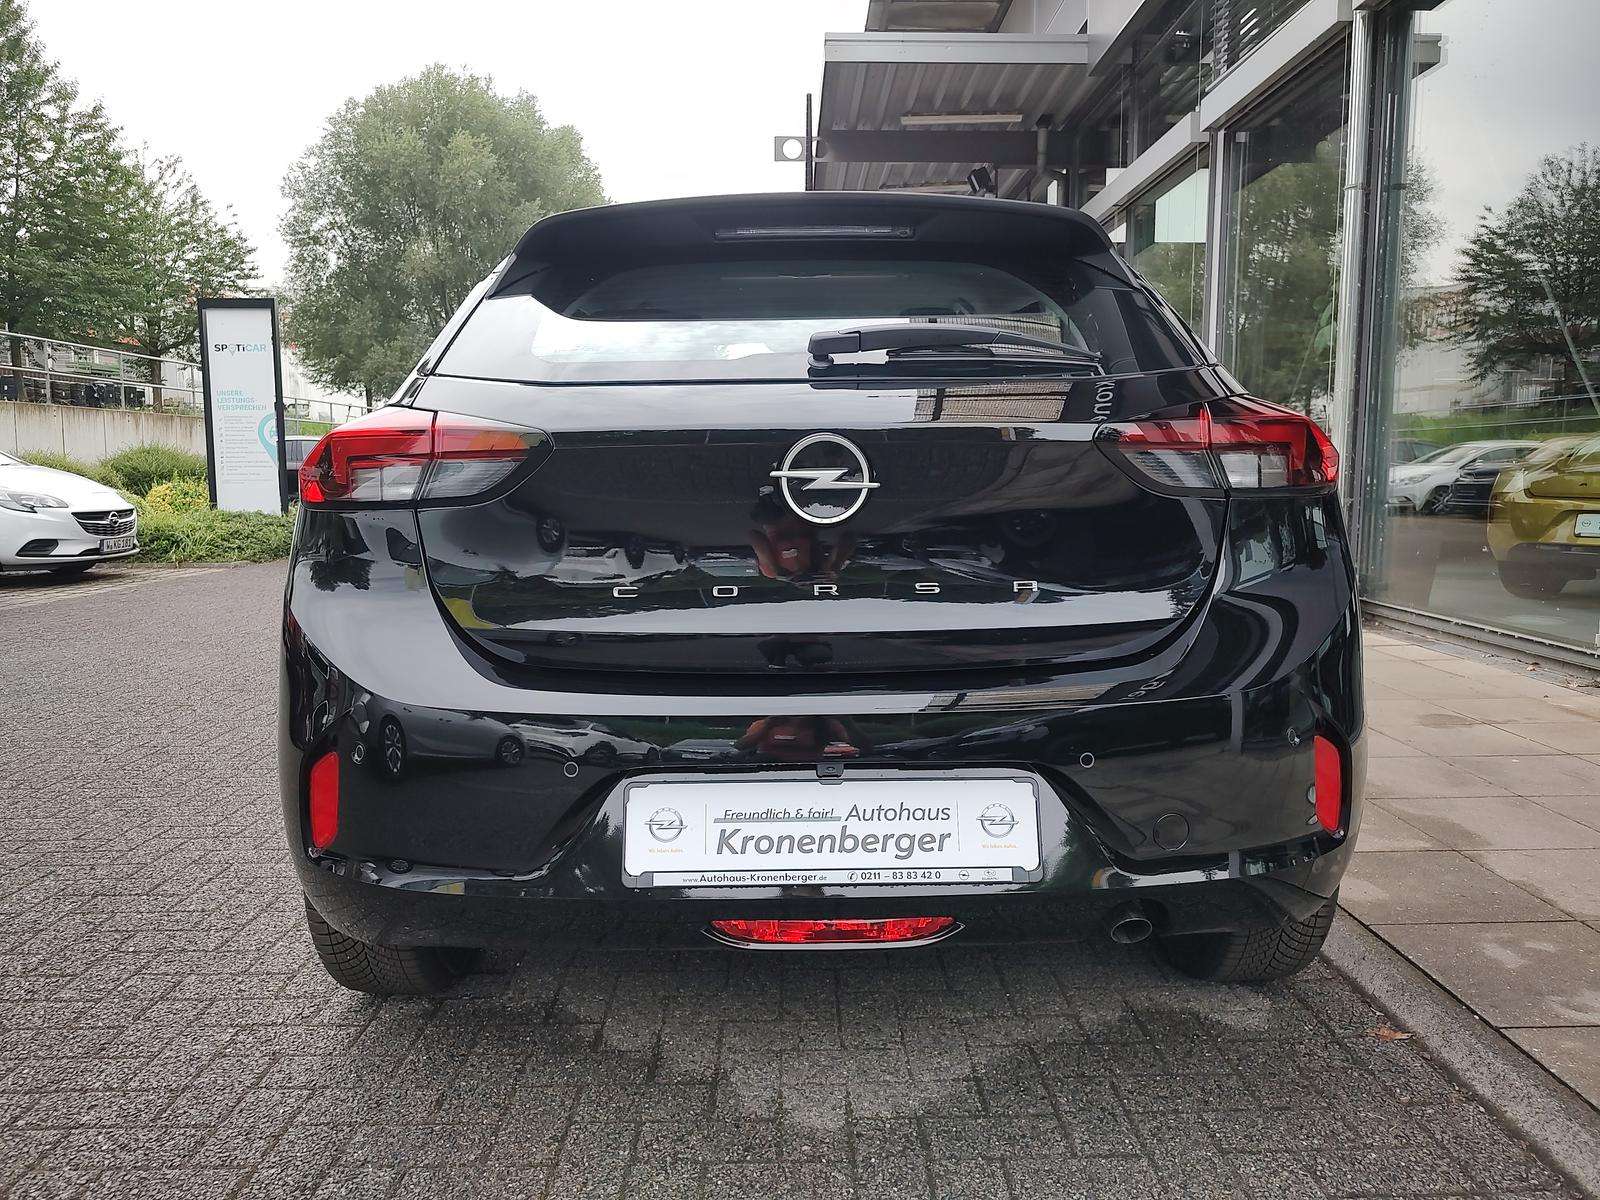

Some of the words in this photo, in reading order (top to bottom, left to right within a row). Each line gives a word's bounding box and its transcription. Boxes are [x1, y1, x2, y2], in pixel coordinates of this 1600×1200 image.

[613, 580, 1039, 598] CORSA
[724, 808, 791, 820] Freundlich
[795, 808, 804, 819] &
[808, 807, 834, 819] fair!
[845, 802, 951, 821] Autohaus
[716, 825, 952, 860] Kronenberger
[682, 872, 827, 883] www.Autohaus-Kronenberger.de
[860, 871, 881, 880] 0211
[892, 870, 904, 880] 83
[906, 870, 918, 880] 83
[920, 870, 932, 880] 42
[934, 870, 941, 880] 0
